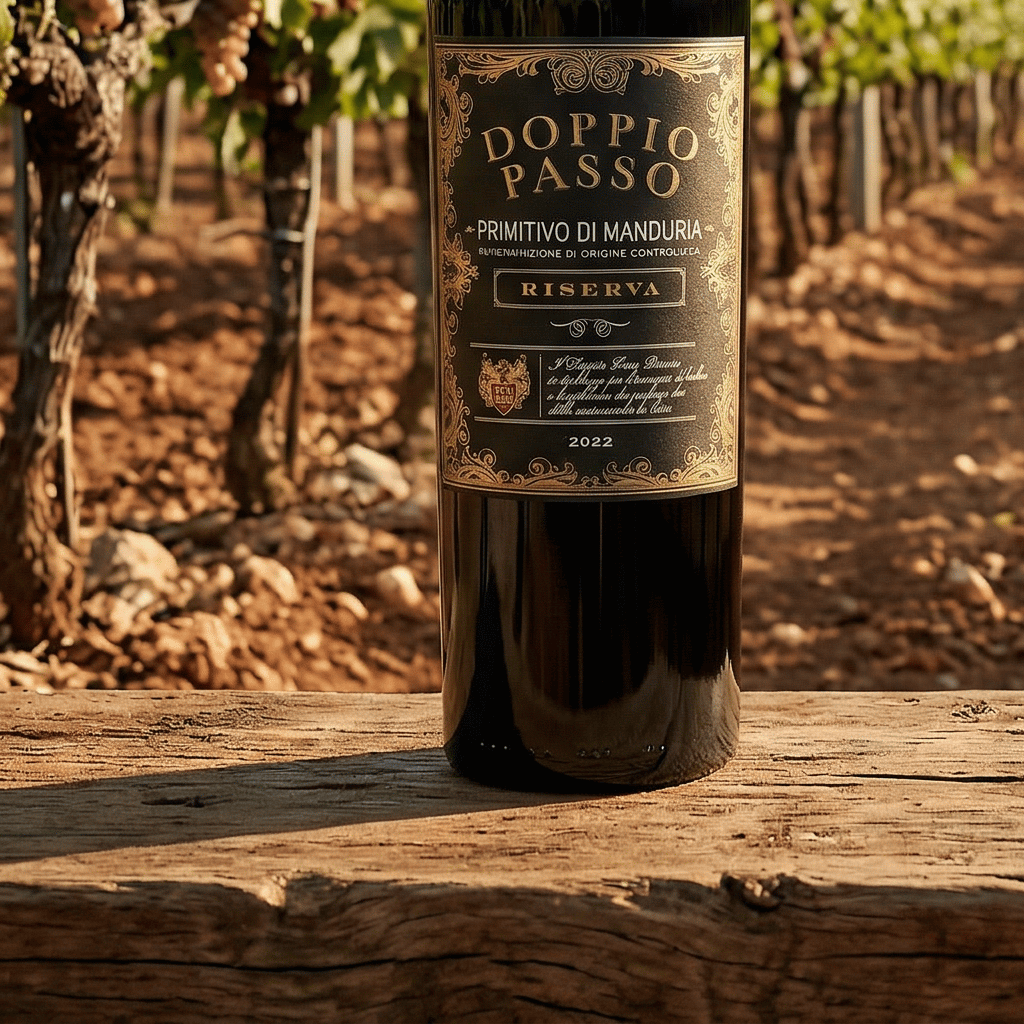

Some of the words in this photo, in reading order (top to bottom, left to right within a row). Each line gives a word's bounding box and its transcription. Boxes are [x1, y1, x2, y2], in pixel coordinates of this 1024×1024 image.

[480, 113, 699, 163] DOPPIO
[500, 154, 681, 201] PASSO
[477, 219, 570, 243] PRIMITIVO
[577, 221, 597, 243] DI
[603, 218, 703, 242] MANDURIA
[566, 249, 577, 259] DI
[580, 249, 627, 258] ORIGINE
[520, 281, 661, 297] RISERVA
[568, 436, 614, 448] 2022
